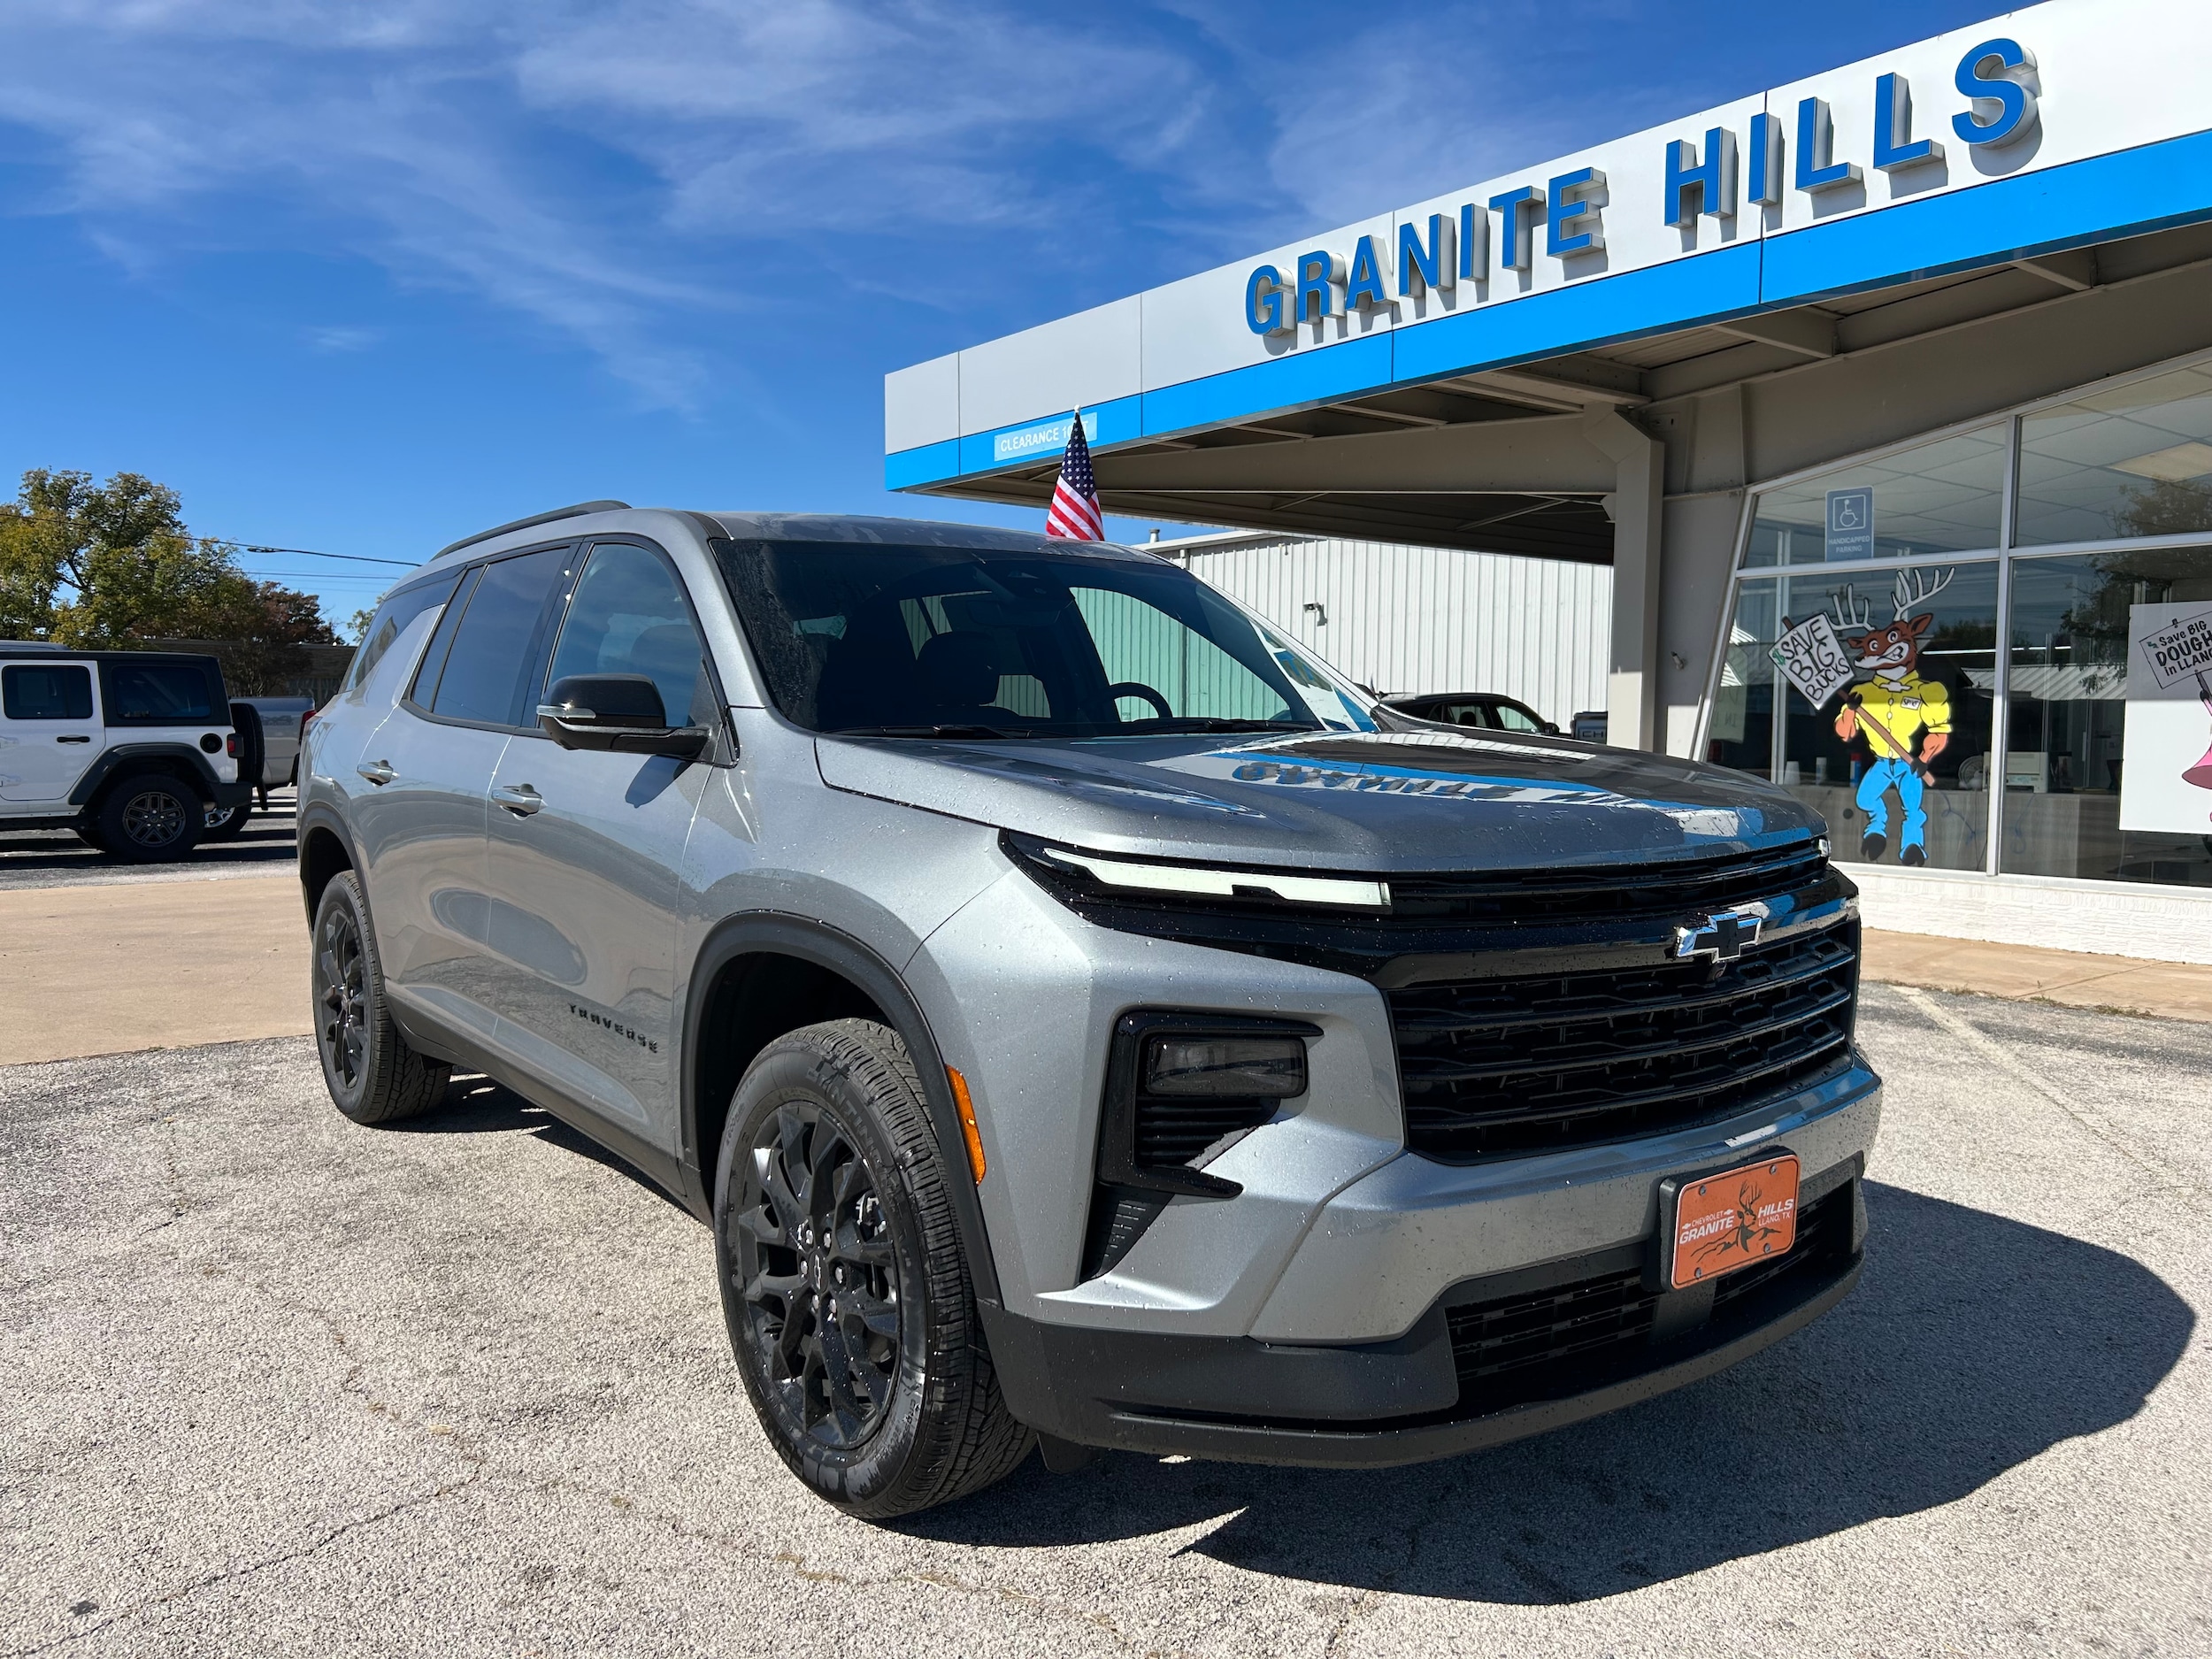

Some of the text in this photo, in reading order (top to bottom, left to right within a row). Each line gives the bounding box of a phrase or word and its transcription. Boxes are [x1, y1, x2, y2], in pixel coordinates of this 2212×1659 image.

[1244, 37, 2037, 336] GRANITE HILLS
[1001, 427, 1059, 452] CLEARANCE
[1828, 535, 1870, 545] HANDICAPPED
[2159, 631, 2186, 646] Save
[2187, 620, 2207, 635] BIG
[1789, 642, 1835, 682] BIG
[2164, 665, 2177, 676] in
[1805, 657, 1850, 702] BUCKS
[568, 1002, 657, 1053] TRAVERSE
[1679, 1199, 1794, 1244] GRANITE HILLS
[1691, 1210, 1724, 1226] CHEVROLET
[1758, 1216, 1780, 1226] LLANO,
